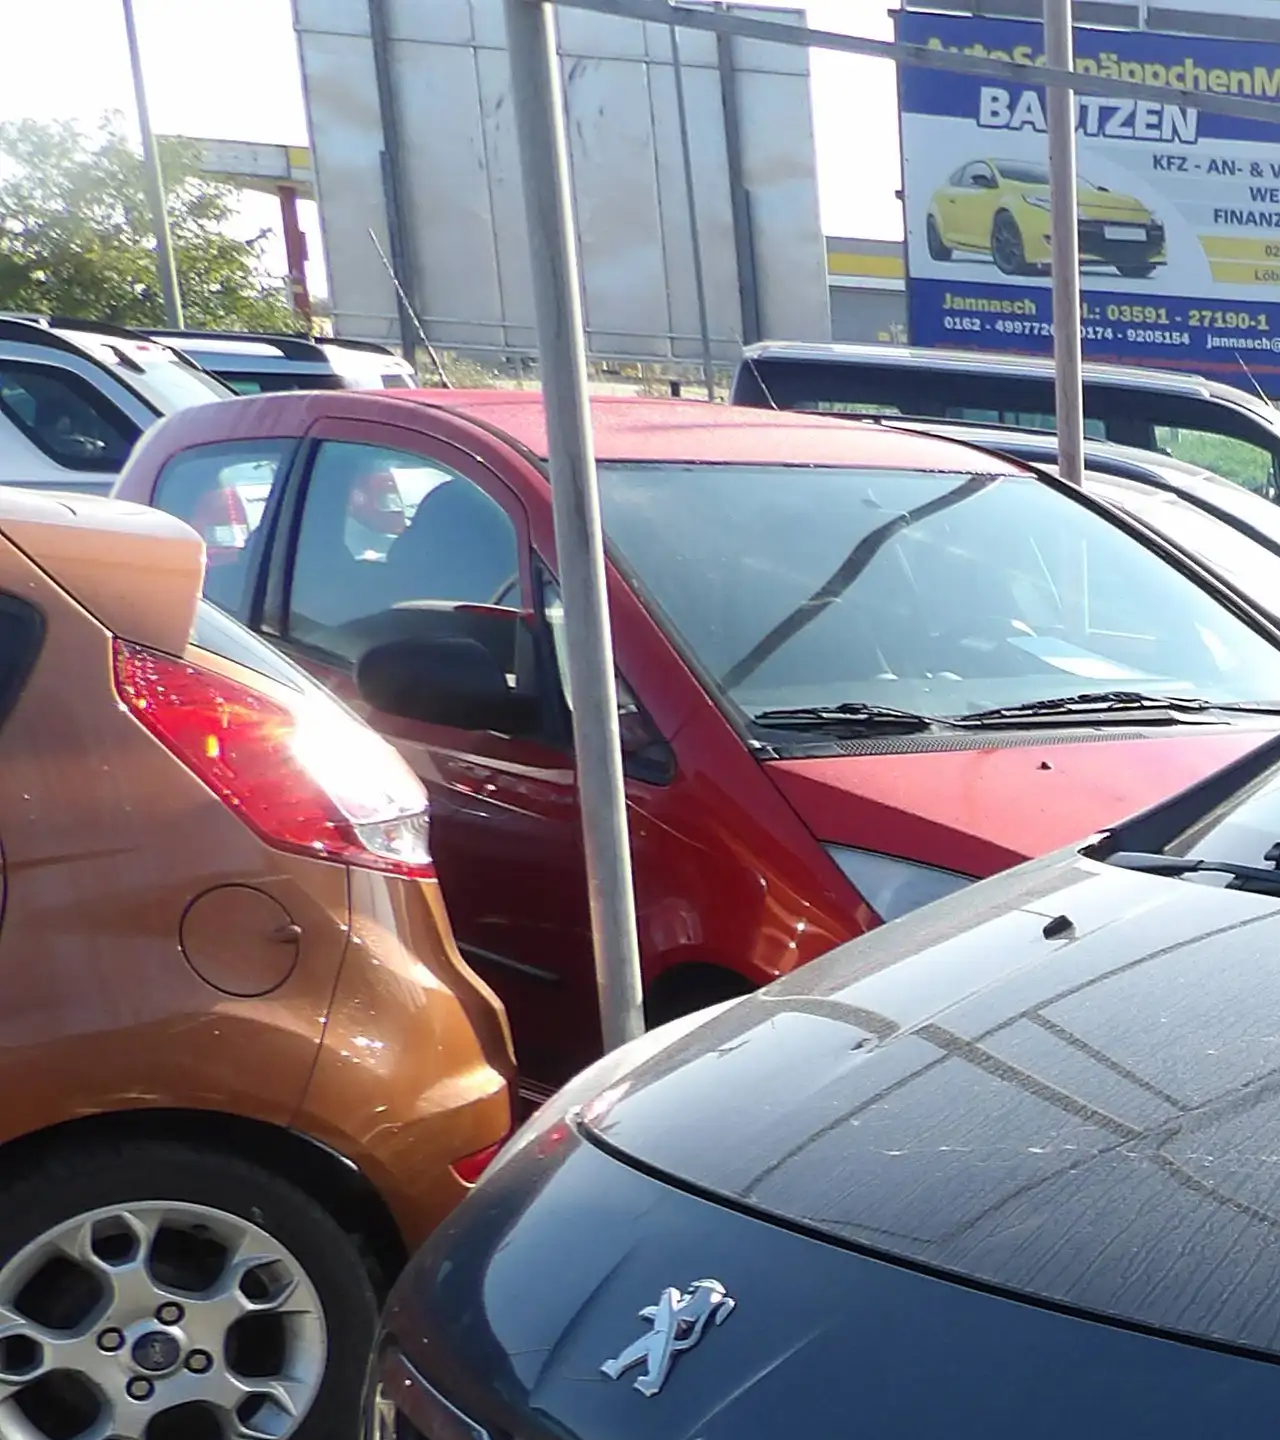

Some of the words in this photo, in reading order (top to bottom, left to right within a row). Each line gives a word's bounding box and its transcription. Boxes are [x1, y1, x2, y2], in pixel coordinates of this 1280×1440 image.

[979, 85, 1199, 144] BATZEN
[1152, 154, 1189, 172] KFZ
[1206, 158, 1243, 176] AN-
[1249, 162, 1264, 178] &
[942, 293, 1036, 316] Jannasch
[1106, 305, 1169, 326] 03591
[1188, 310, 1269, 331] 27190-1
[944, 316, 981, 331] 0162
[1127, 328, 1190, 346] 9205154
